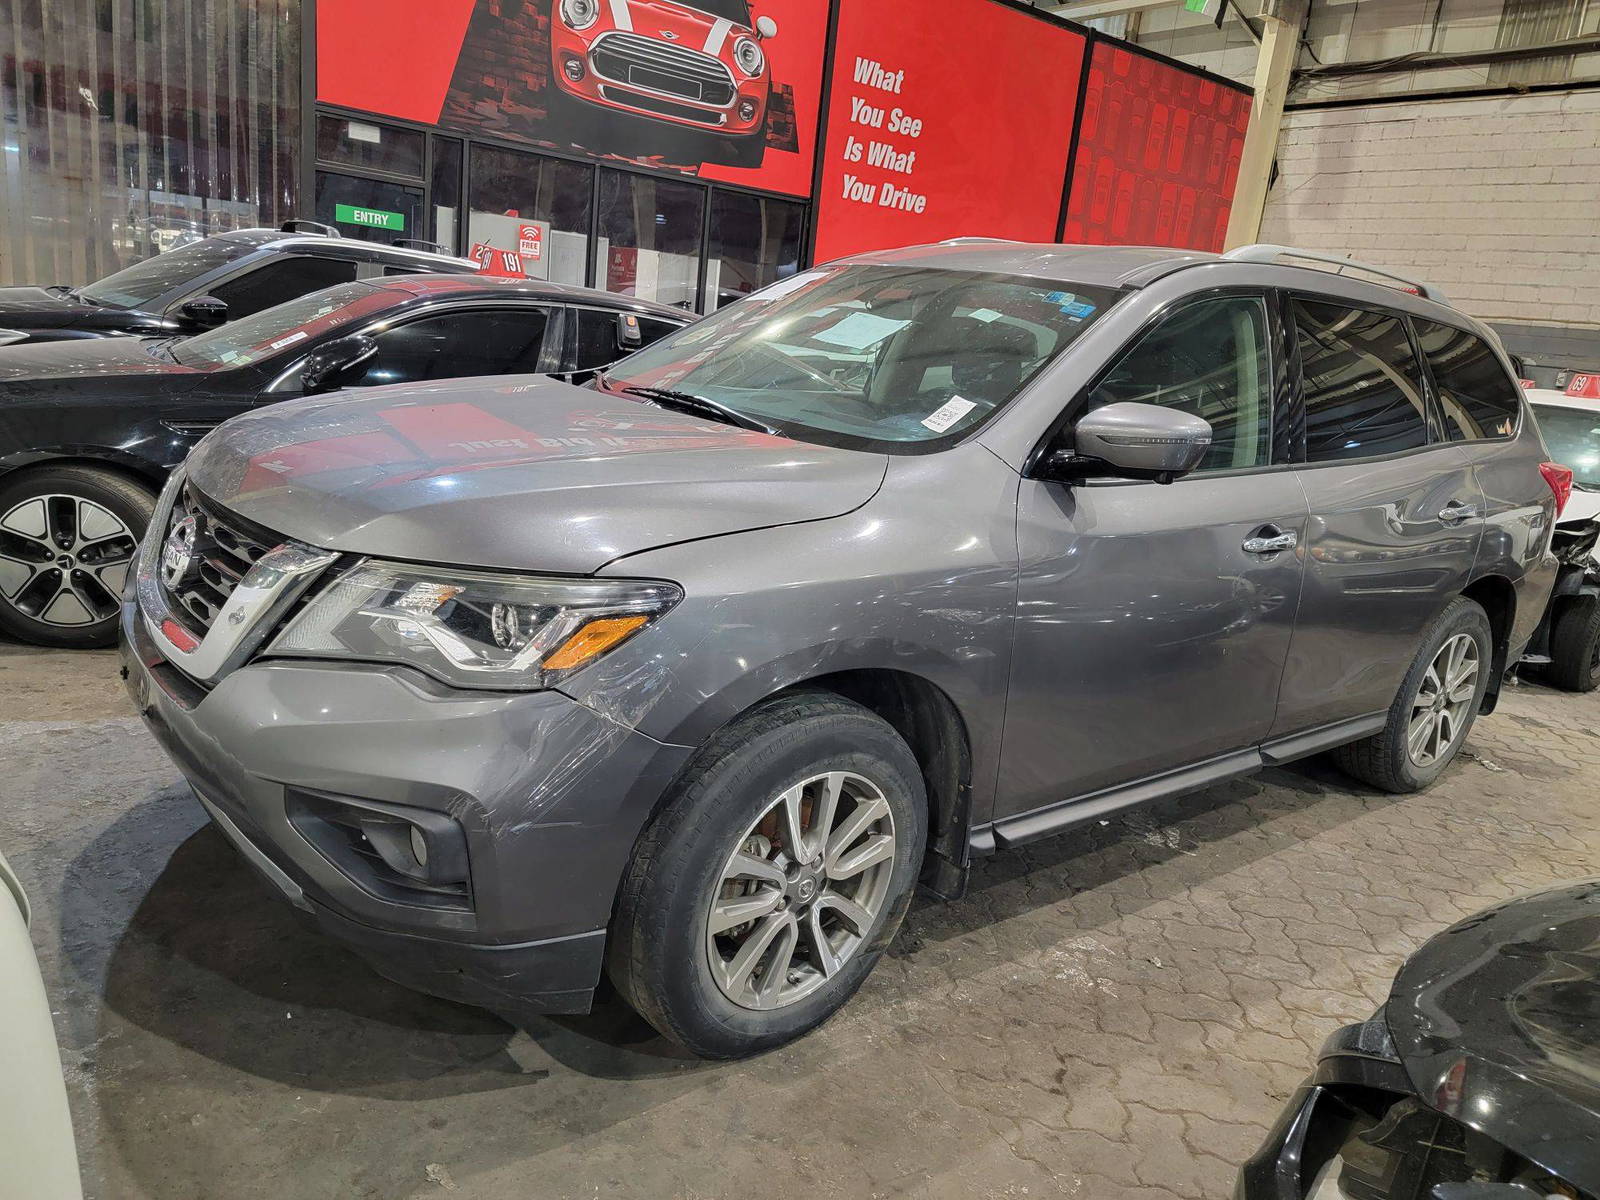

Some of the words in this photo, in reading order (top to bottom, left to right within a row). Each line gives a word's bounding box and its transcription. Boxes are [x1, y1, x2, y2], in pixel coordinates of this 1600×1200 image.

[854, 56, 904, 94] What
[850, 96, 885, 128] You
[887, 107, 923, 138] See
[843, 135, 863, 162] Is
[867, 141, 916, 174] What
[842, 173, 876, 204] You
[879, 182, 927, 214] Drive
[353, 209, 389, 226] ENTRY
[521, 241, 538, 250] FREE
[502, 252, 522, 272] 191
[1572, 376, 1587, 391] 69
